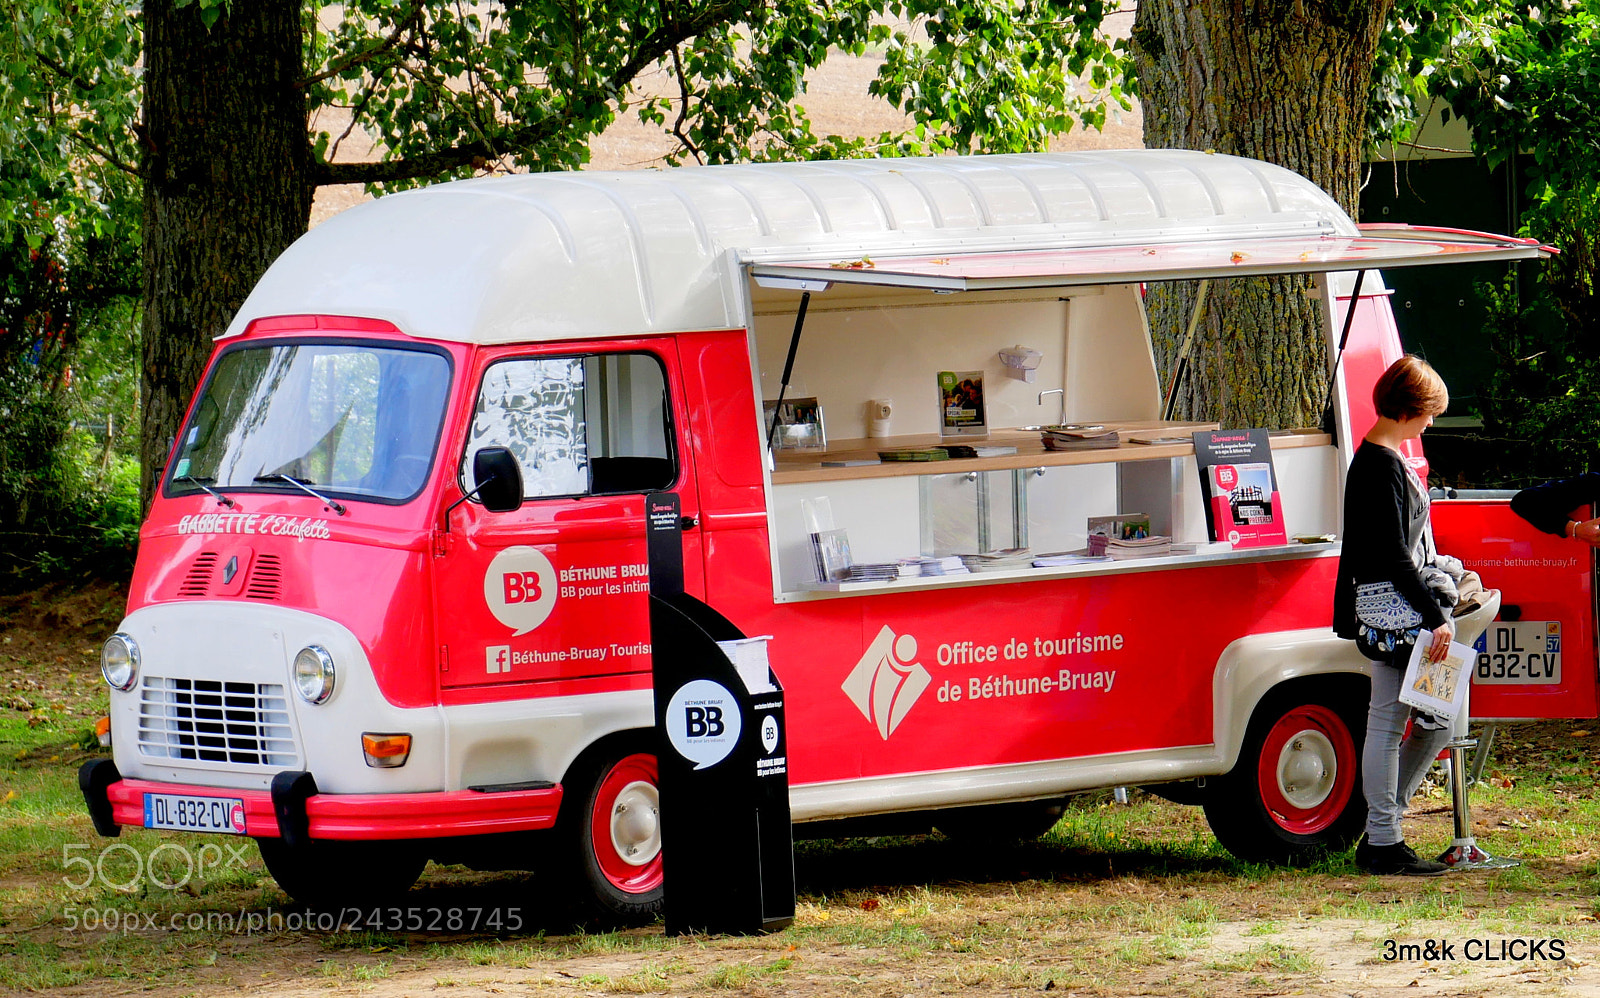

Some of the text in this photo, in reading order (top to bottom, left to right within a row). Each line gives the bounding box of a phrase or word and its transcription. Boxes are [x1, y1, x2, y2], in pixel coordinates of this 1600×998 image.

[178, 514, 331, 543] BABBETTE l'Estafette
[560, 566, 617, 582] BÉTHUNE
[1463, 557, 1577, 569] tourisme-bethune-bruay.fr
[502, 571, 542, 605] BB
[561, 586, 576, 598] BB
[578, 586, 603, 599] pour
[605, 582, 621, 595] les
[512, 646, 607, 665] Béthune-Bruay
[609, 641, 652, 657] Touris
[936, 631, 1125, 666] Office de tourisme
[1547, 637, 1560, 651] 57
[936, 669, 1117, 703] de Béthune-Bruay
[685, 706, 725, 738] BB
[766, 727, 775, 740] BB
